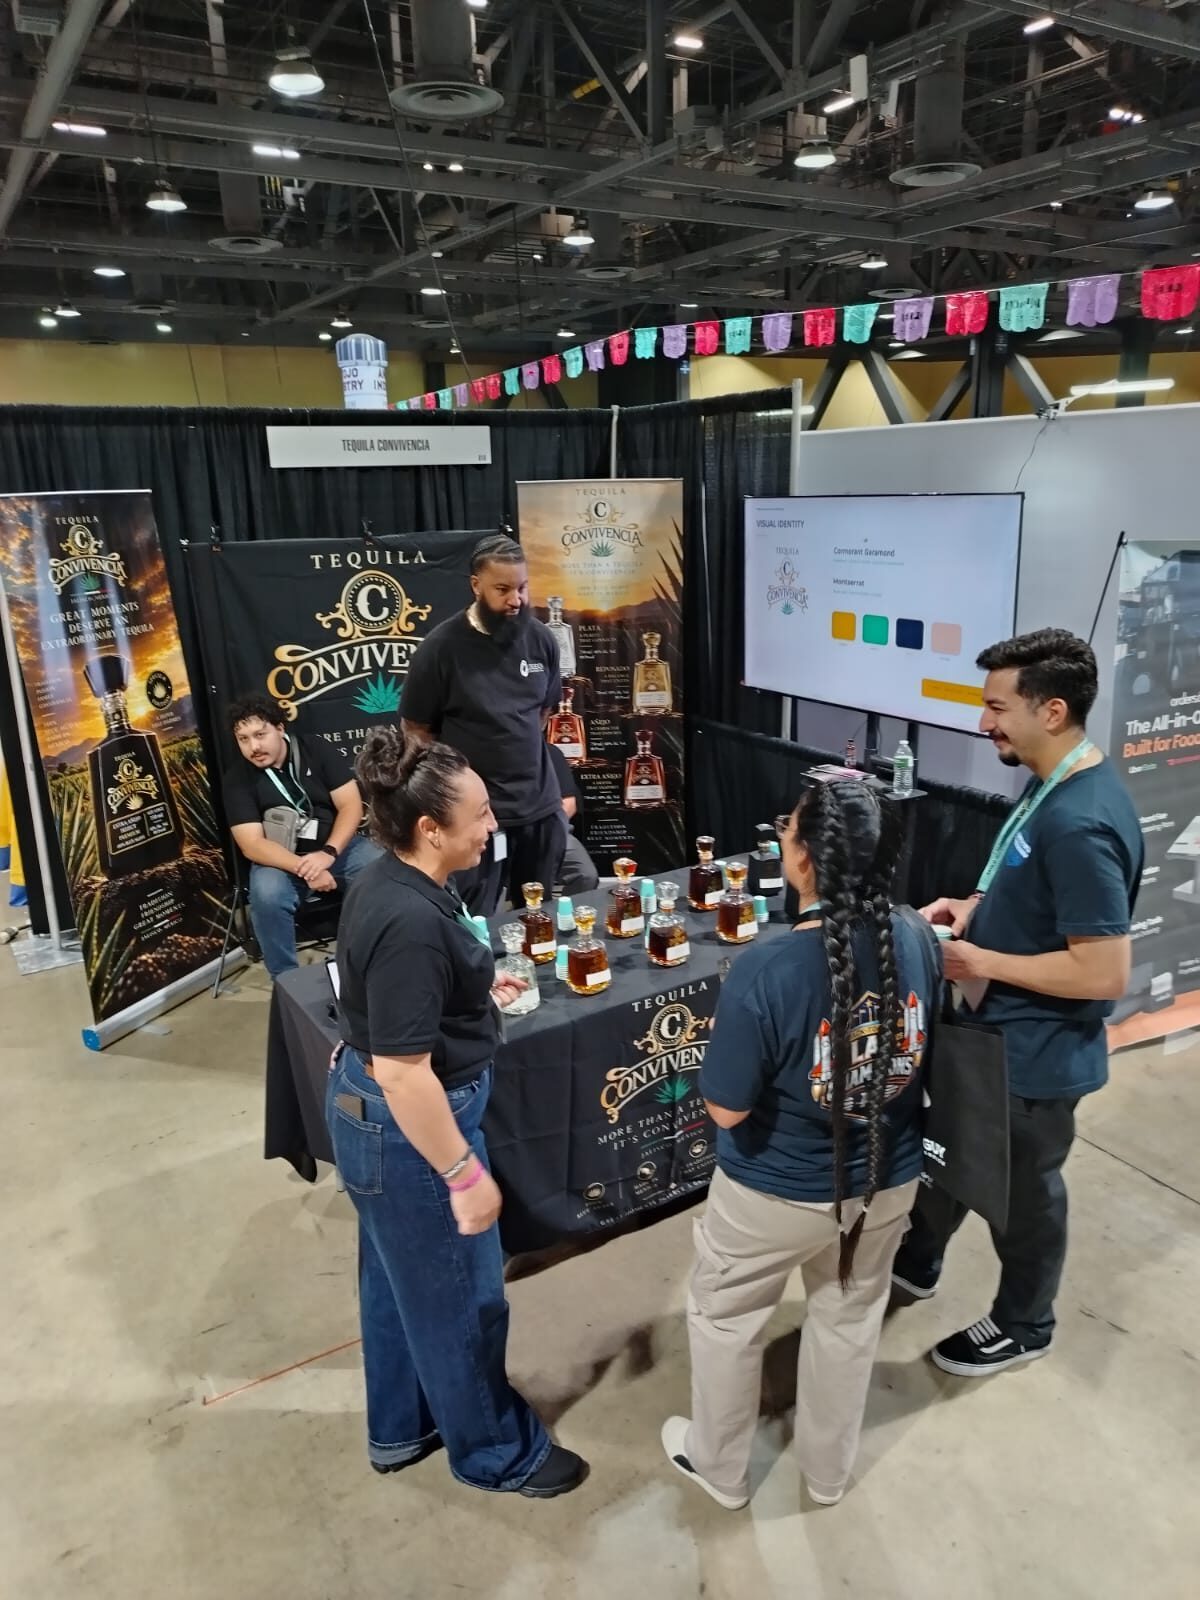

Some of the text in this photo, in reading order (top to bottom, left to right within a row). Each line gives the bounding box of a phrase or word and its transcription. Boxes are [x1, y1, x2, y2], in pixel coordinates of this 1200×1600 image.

[342, 439, 430, 453] TEQUILA CONVIVENCIA
[575, 488, 626, 497] TEQUILA
[594, 502, 607, 518] C
[55, 515, 99, 526] TEQUILA
[756, 519, 805, 529] VISUAL IDENTITY
[74, 530, 87, 549] C
[561, 527, 644, 547] CONVIVENCIA
[310, 550, 427, 570] TEQUILA
[48, 557, 128, 584] CONVIVENCIA
[50, 601, 140, 624] GREAT MOMENTS
[356, 584, 390, 622] C
[69, 616, 130, 634] DESERVE AN
[40, 623, 155, 650] EXTRAORDINARY TEQUILA
[1125, 719, 1151, 736] The
[1123, 739, 1153, 758] Built
[1153, 736, 1172, 753] for
[631, 981, 708, 1013] TEQUILA
[659, 1011, 682, 1040] C
[597, 1124, 633, 1145] MORE
[638, 1110, 672, 1128] THAN
[677, 1105, 684, 1113] A
[613, 1135, 638, 1151] IT'S
